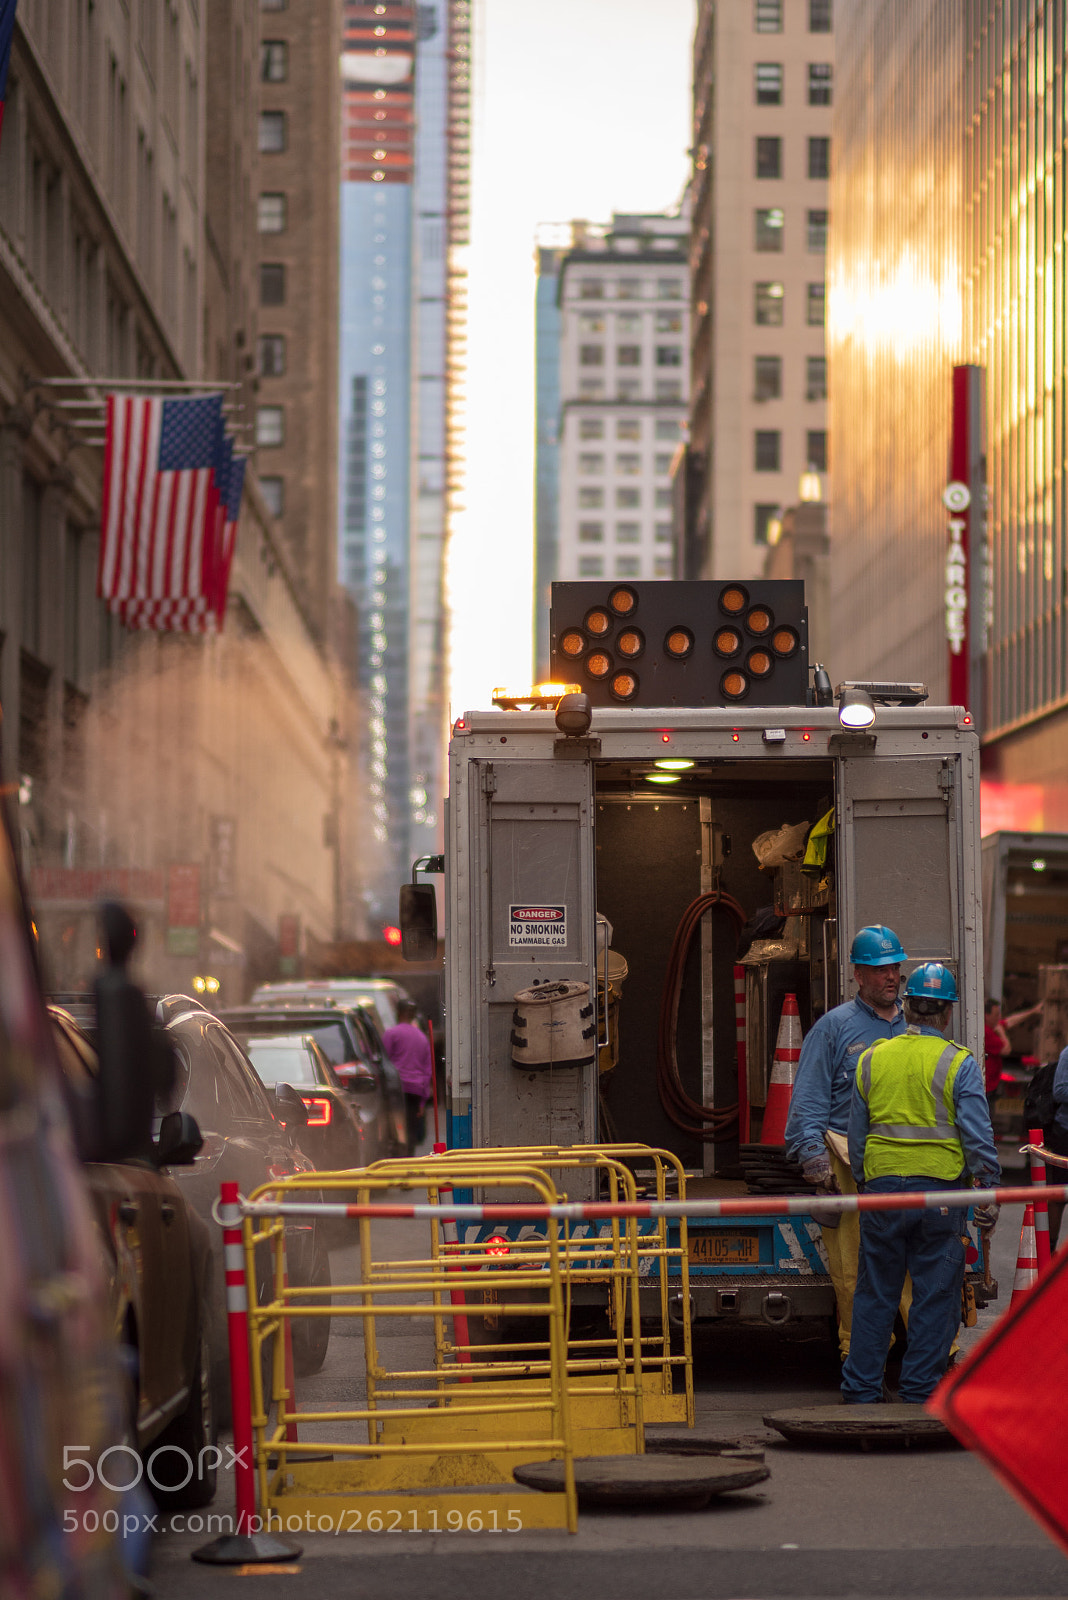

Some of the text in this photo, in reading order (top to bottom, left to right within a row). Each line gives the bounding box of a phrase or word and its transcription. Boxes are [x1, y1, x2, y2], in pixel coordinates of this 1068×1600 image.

[945, 519, 967, 655] TARGET
[519, 910, 557, 918] DANGER
[510, 924, 566, 935] NO SMOKING
[510, 937, 566, 945] FLAMMABLE GAS
[693, 1238, 729, 1257] 44105
